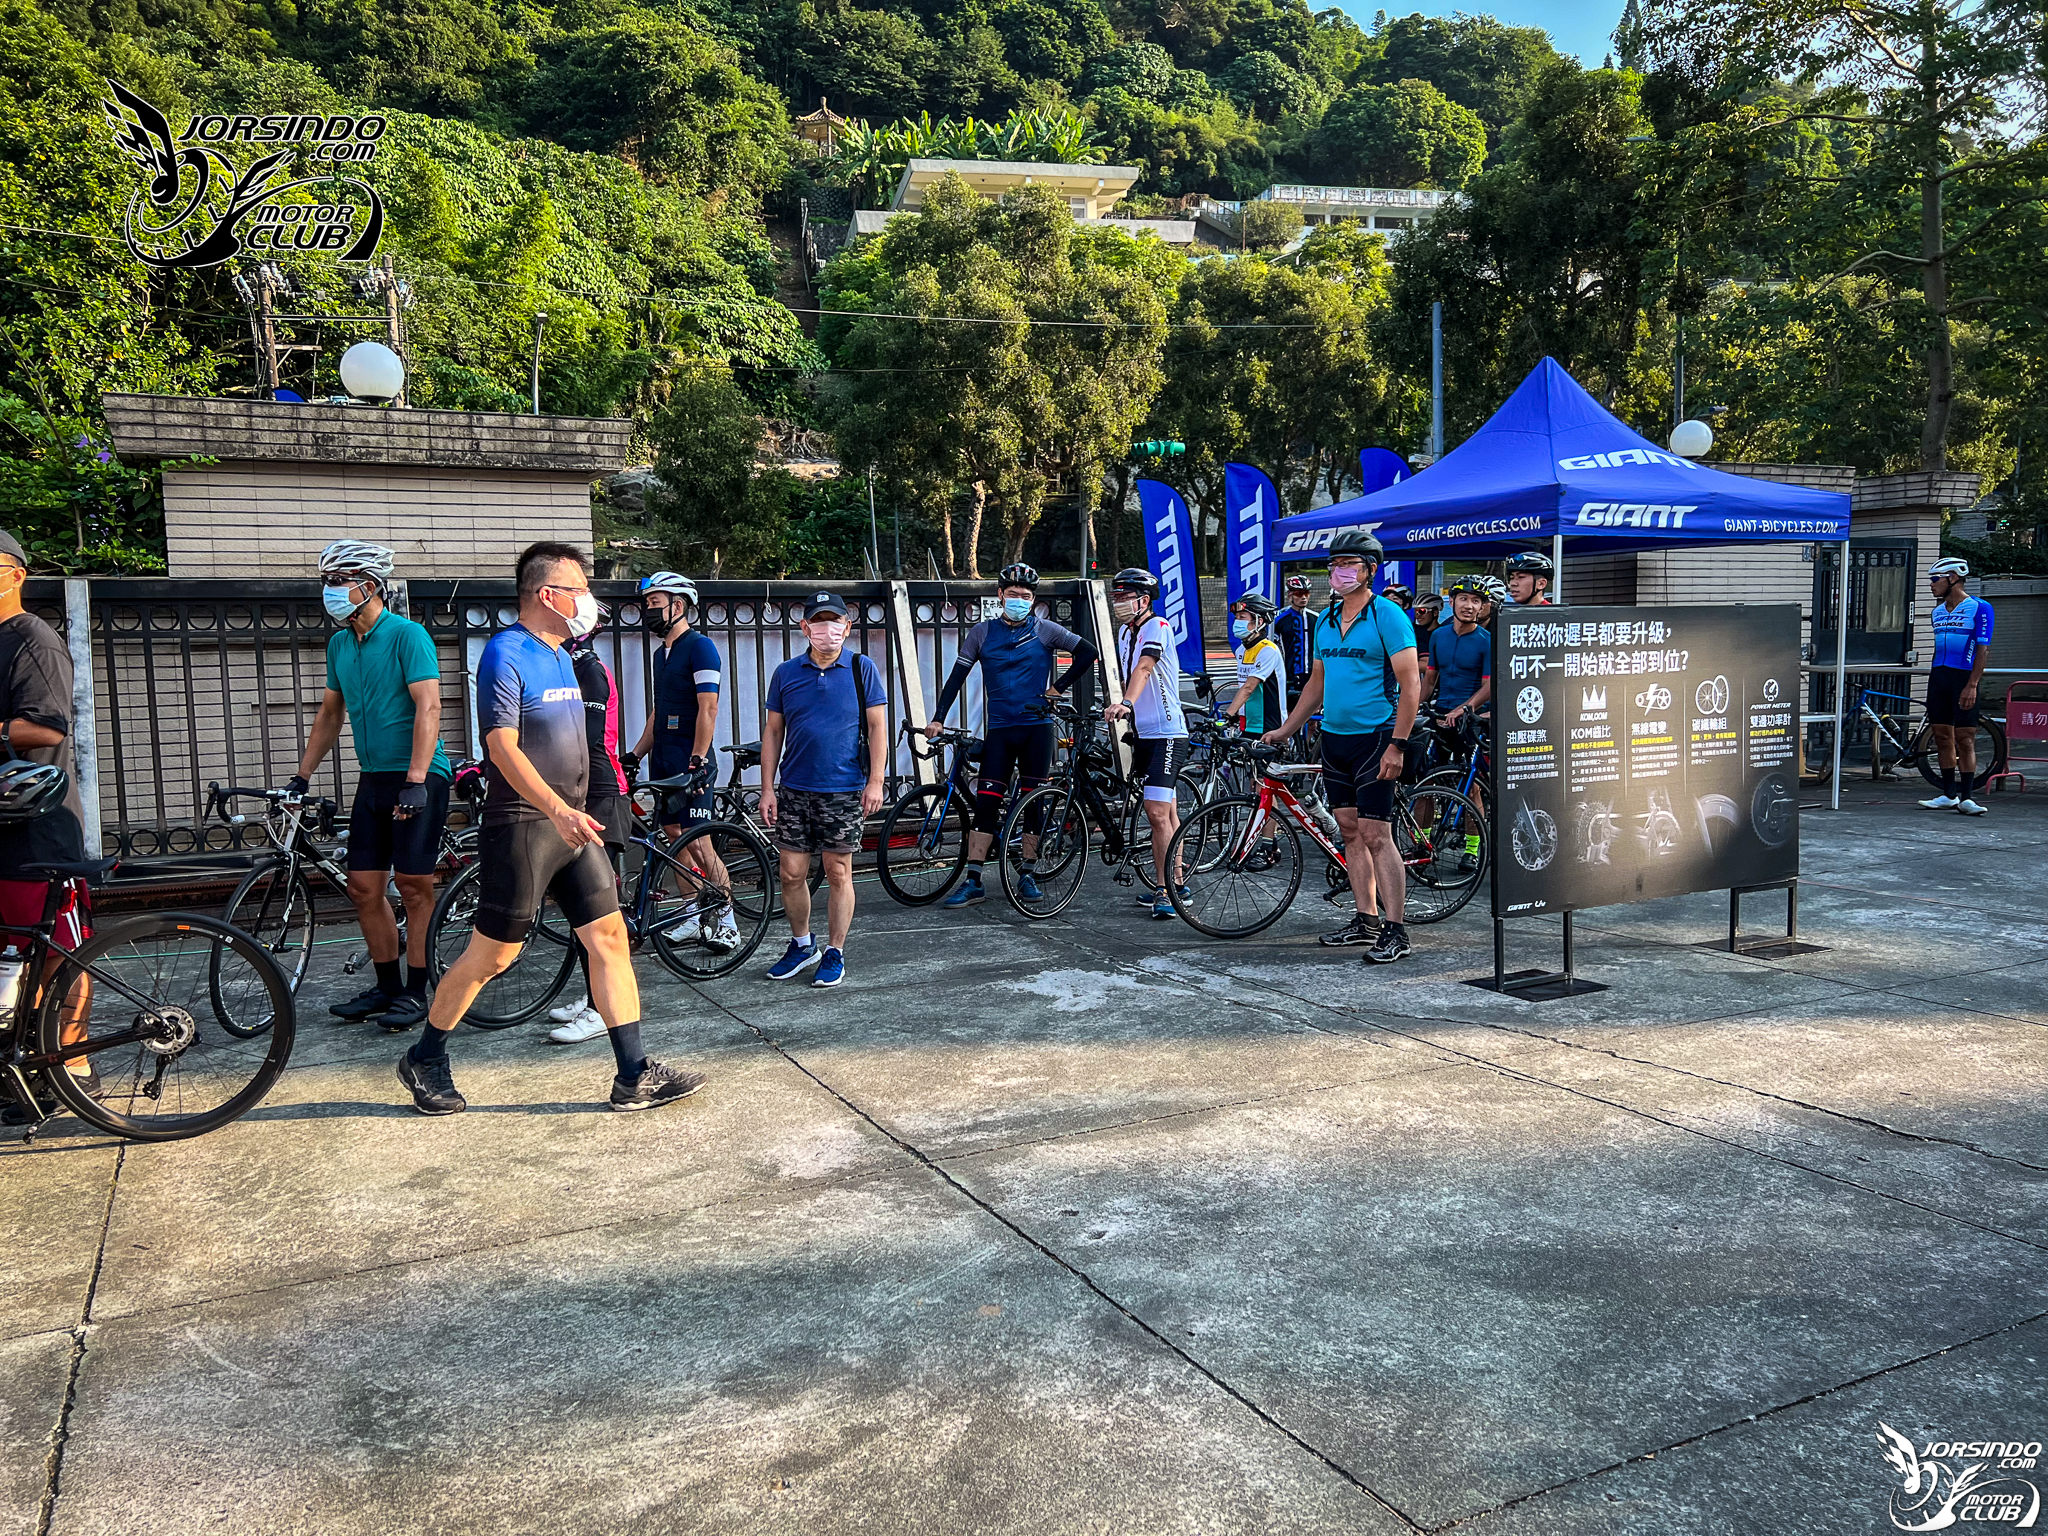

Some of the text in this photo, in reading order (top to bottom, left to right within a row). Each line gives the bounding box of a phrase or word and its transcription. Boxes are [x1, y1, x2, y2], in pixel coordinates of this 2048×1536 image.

[1558, 448, 1698, 471] GIANT
[1575, 502, 1698, 529] GIANT
[1406, 515, 1541, 542] GIANT-BICYCLES.COM
[1723, 518, 1838, 534] GIANT-BICYCLES.COM
[542, 688, 582, 702] GIAN
[1157, 673, 1172, 722] PINARELLO
[1750, 703, 1772, 711] POWER
[2022, 712, 2048, 726] 請勿
[1506, 729, 1547, 744] 油壓碟煞
[1163, 736, 1175, 775] PINARE
[690, 808, 712, 820] RAPH
